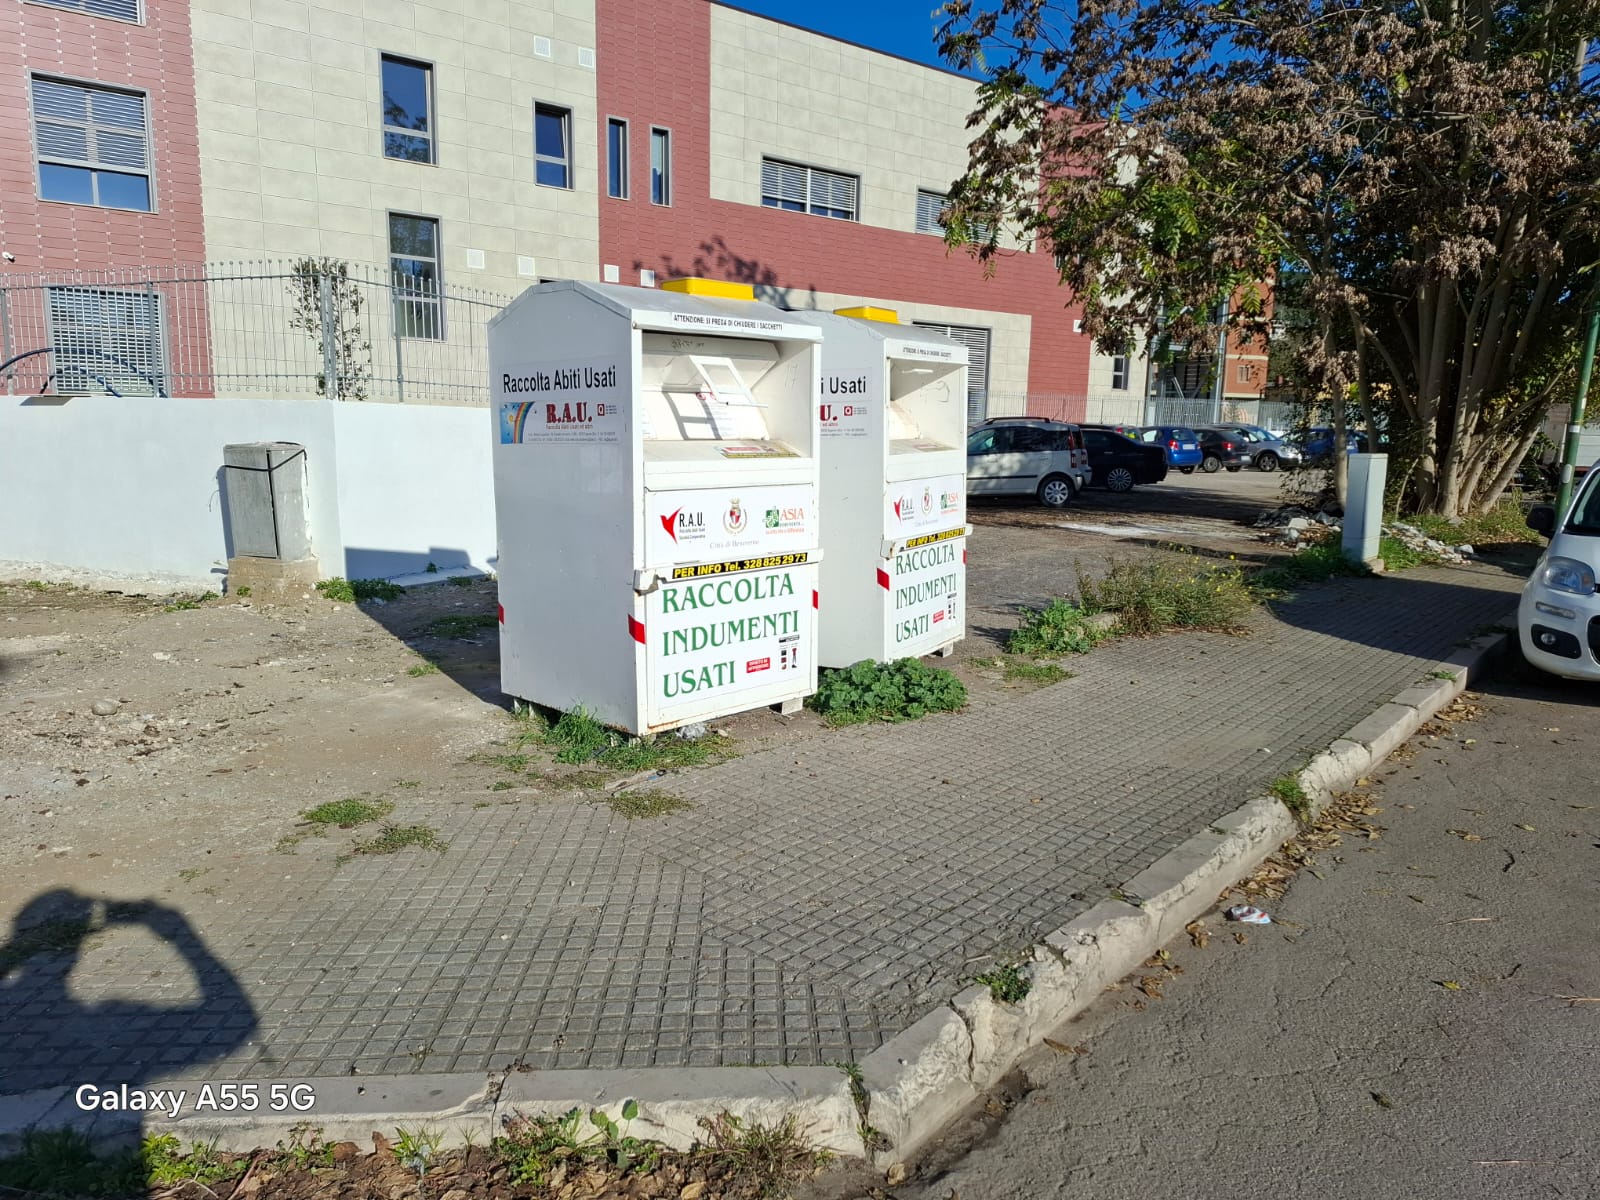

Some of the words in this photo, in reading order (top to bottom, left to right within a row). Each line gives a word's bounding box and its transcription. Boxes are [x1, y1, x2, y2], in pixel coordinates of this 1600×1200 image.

[503, 371, 551, 393] Raccolta
[553, 368, 581, 390] Abiti
[584, 365, 616, 389] Usati
[829, 376, 866, 394] Usati
[546, 402, 593, 423] R.A.U.
[679, 512, 705, 527] R.A.U.
[780, 507, 805, 521] ASIA
[674, 567, 694, 579] PER
[697, 563, 722, 576] INFO
[724, 562, 741, 573] Tel.
[744, 559, 761, 570] 328
[763, 556, 781, 567] 825
[782, 555, 794, 565] 29
[795, 553, 807, 563] 73
[896, 543, 955, 576] RACCOLTA
[662, 573, 794, 614] RACCOLTA
[896, 573, 957, 610] INDUMENTI
[663, 610, 799, 657] INDUMENTI
[896, 613, 929, 643] USATI
[663, 660, 736, 698] USATI
